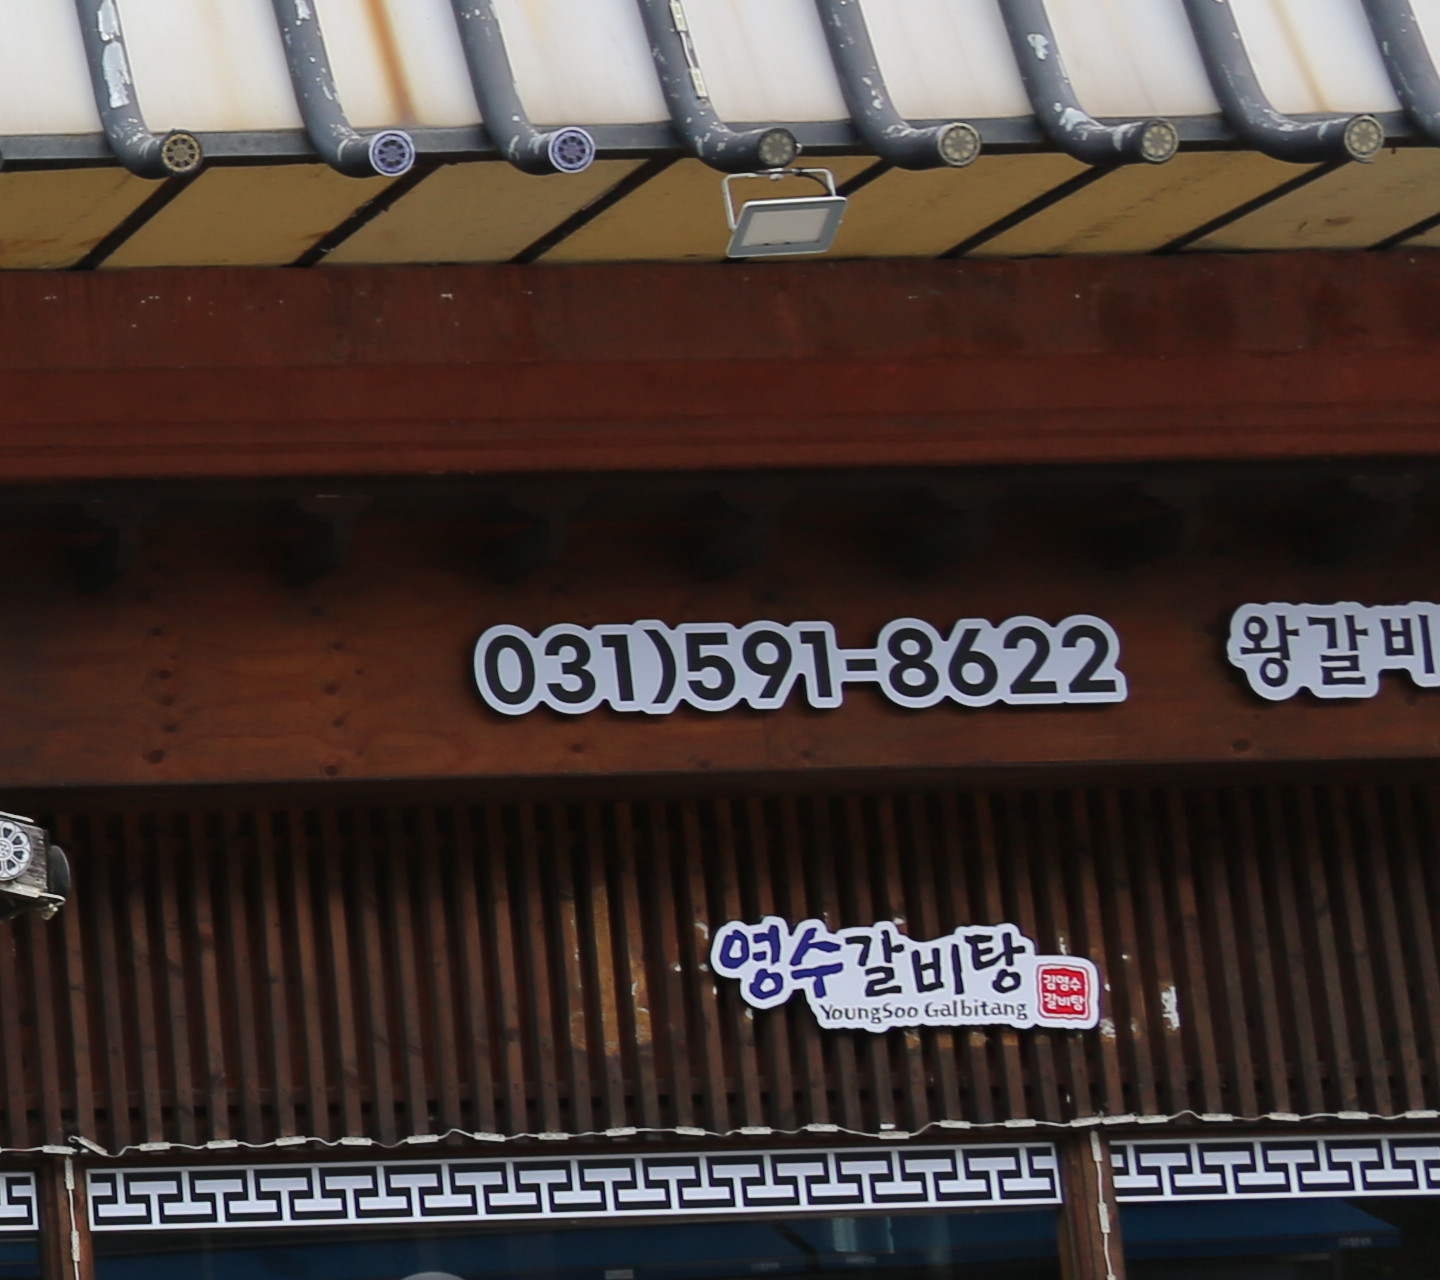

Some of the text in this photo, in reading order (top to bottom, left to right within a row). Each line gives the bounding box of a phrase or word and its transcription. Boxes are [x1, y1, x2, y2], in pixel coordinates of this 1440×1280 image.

[484, 624, 1117, 705] 031)591-8622
[1240, 614, 1436, 688] 왕갈비
[719, 924, 1026, 999] 영수갈비탕
[1043, 974, 1082, 991] 김영수
[820, 999, 1029, 1024] YoungSoo Galbitang
[1043, 993, 1085, 1012] 갈비탕
